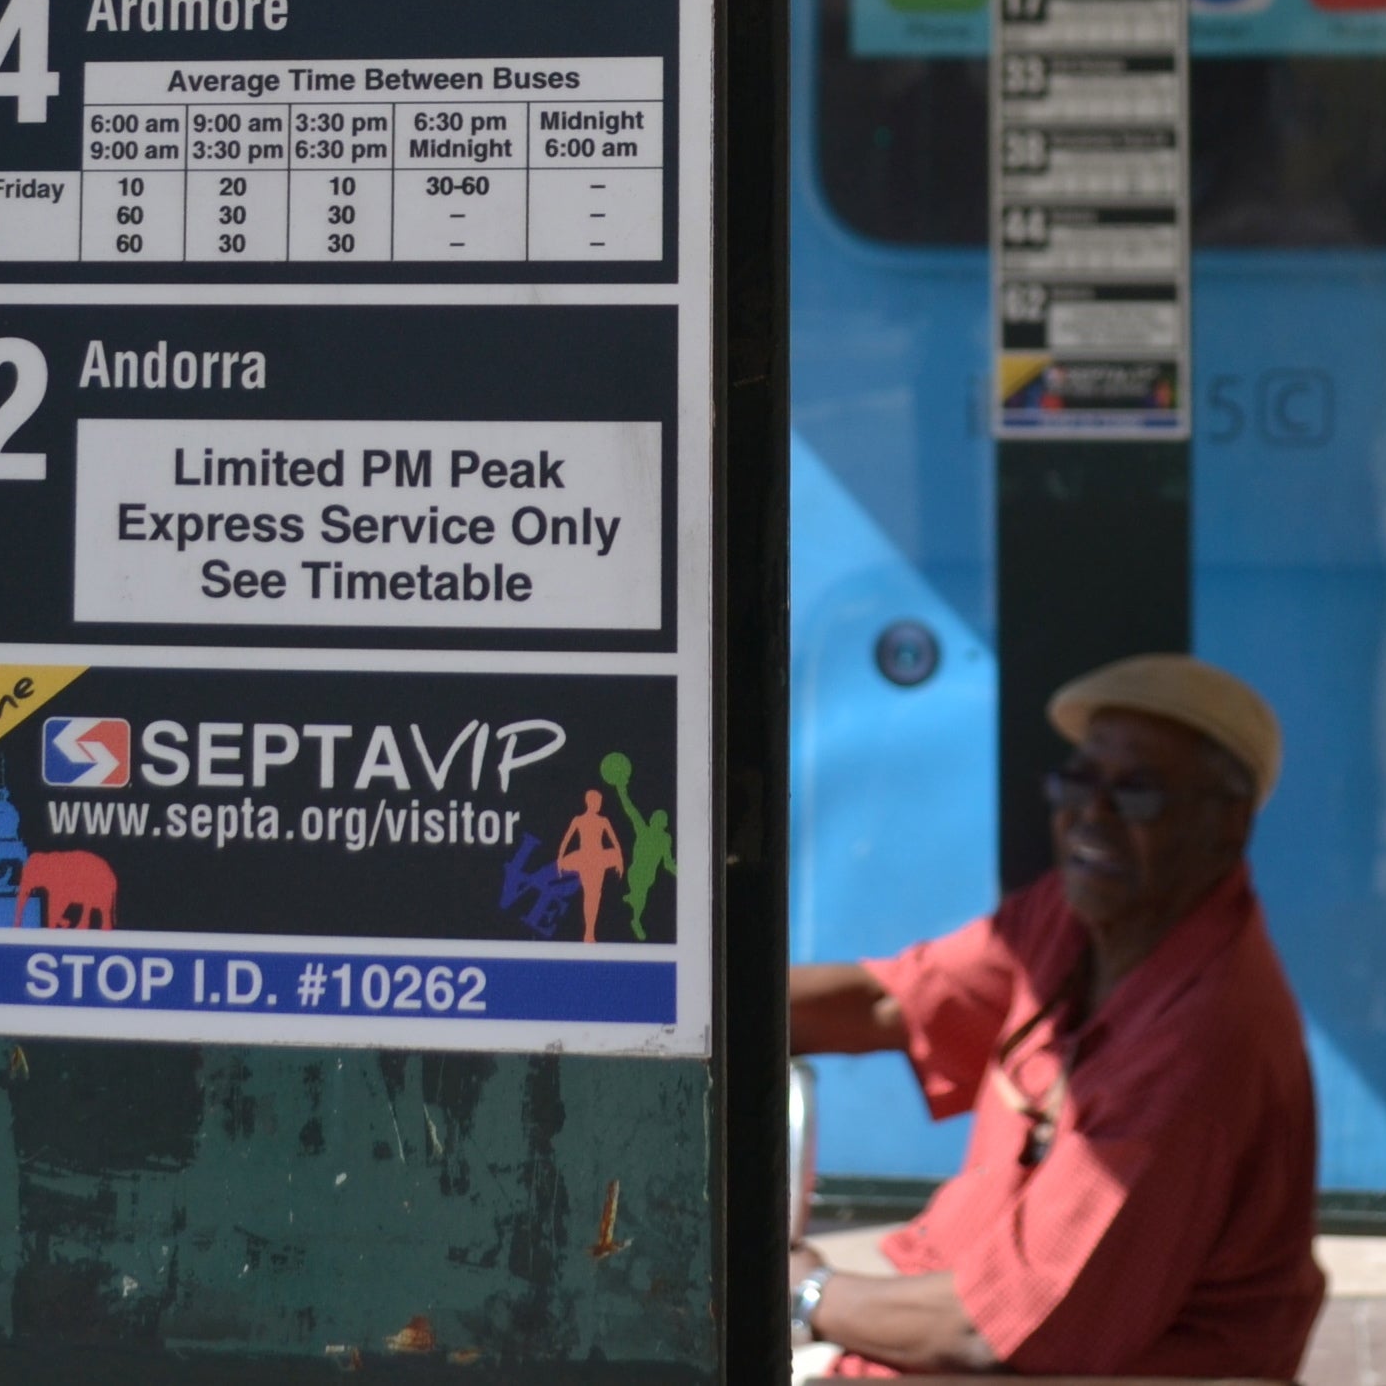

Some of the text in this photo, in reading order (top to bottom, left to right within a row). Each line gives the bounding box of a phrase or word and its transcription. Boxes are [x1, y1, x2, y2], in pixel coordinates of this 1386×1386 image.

[166, 67, 581, 98] Average Time Between Buses
[425, 175, 491, 197] 30-60
[78, 340, 266, 390] Andorra
[174, 448, 565, 488] Limited PM Peak
[117, 502, 621, 557] Express Service Only
[201, 559, 533, 602] See Timetable
[48, 798, 520, 852] www.septa.org/visitor
[27, 954, 486, 1009] STOP I.D. #10262
